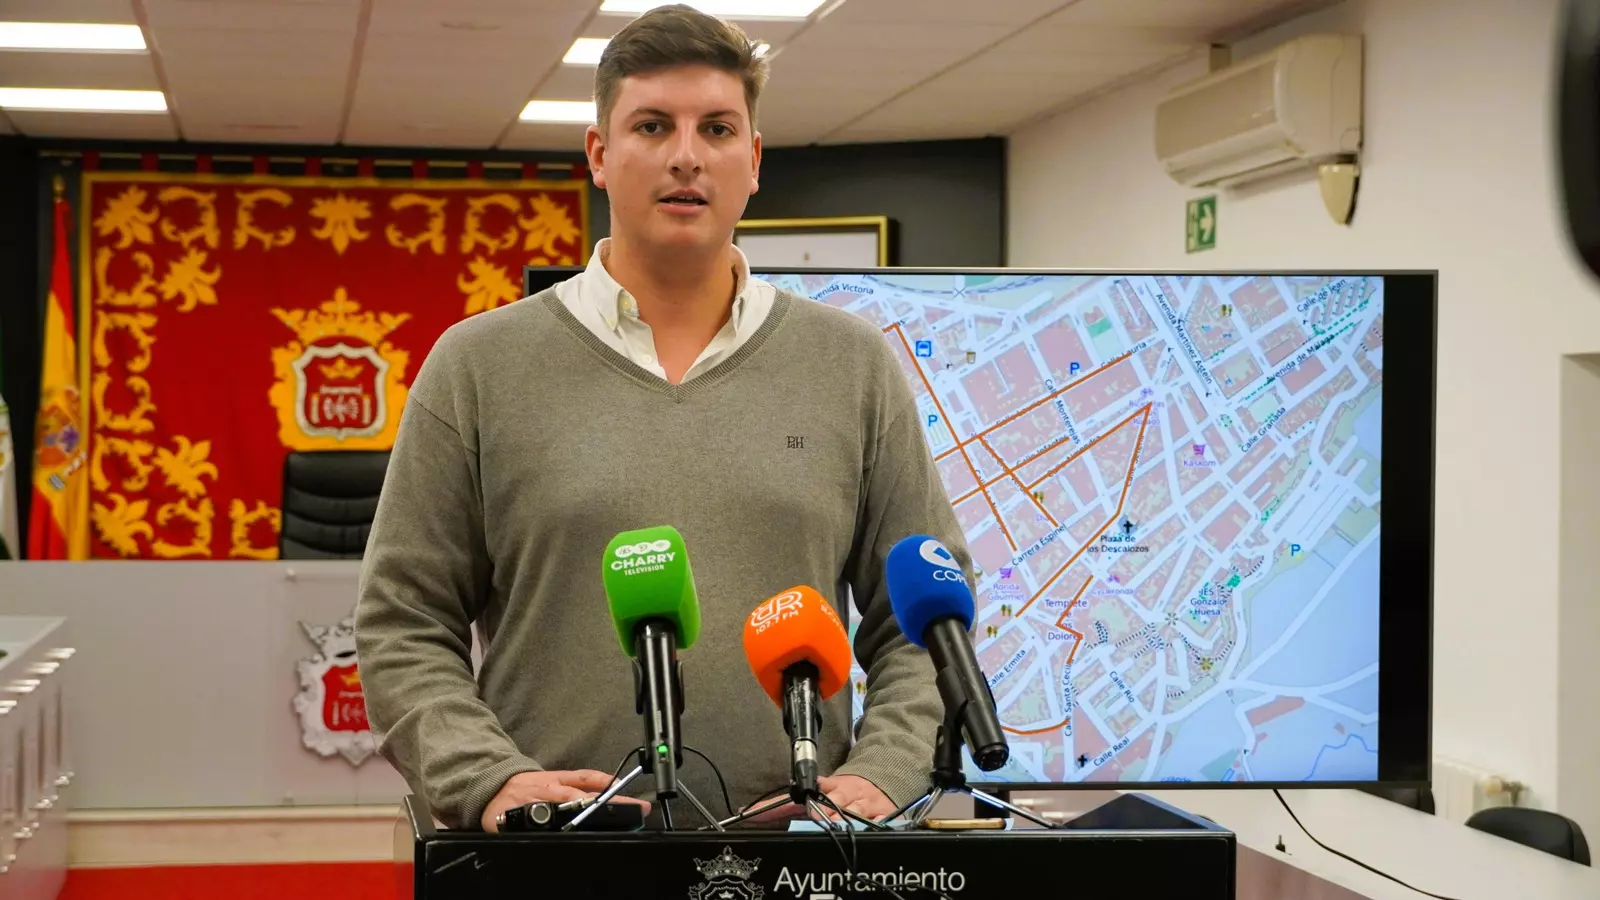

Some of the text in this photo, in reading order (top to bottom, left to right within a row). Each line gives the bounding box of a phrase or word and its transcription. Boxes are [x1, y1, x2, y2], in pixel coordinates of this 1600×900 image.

[842, 283, 874, 295] Victoria
[1156, 293, 1178, 325] Avenida
[1296, 351, 1307, 364] de
[1240, 406, 1287, 453] Calle Granada
[1011, 524, 1067, 567] Carrera Espinel
[1124, 535, 1136, 543] de
[610, 551, 677, 571] CHARRY
[932, 570, 967, 584] COP
[1045, 599, 1088, 608] Tempete
[782, 609, 799, 620] FM
[987, 649, 1027, 688] Calle Ermita
[1108, 670, 1126, 691] Calle
[1064, 686, 1073, 714] Santa
[1093, 736, 1131, 767] Calle Real
[774, 866, 966, 898] Ayuntamiento
